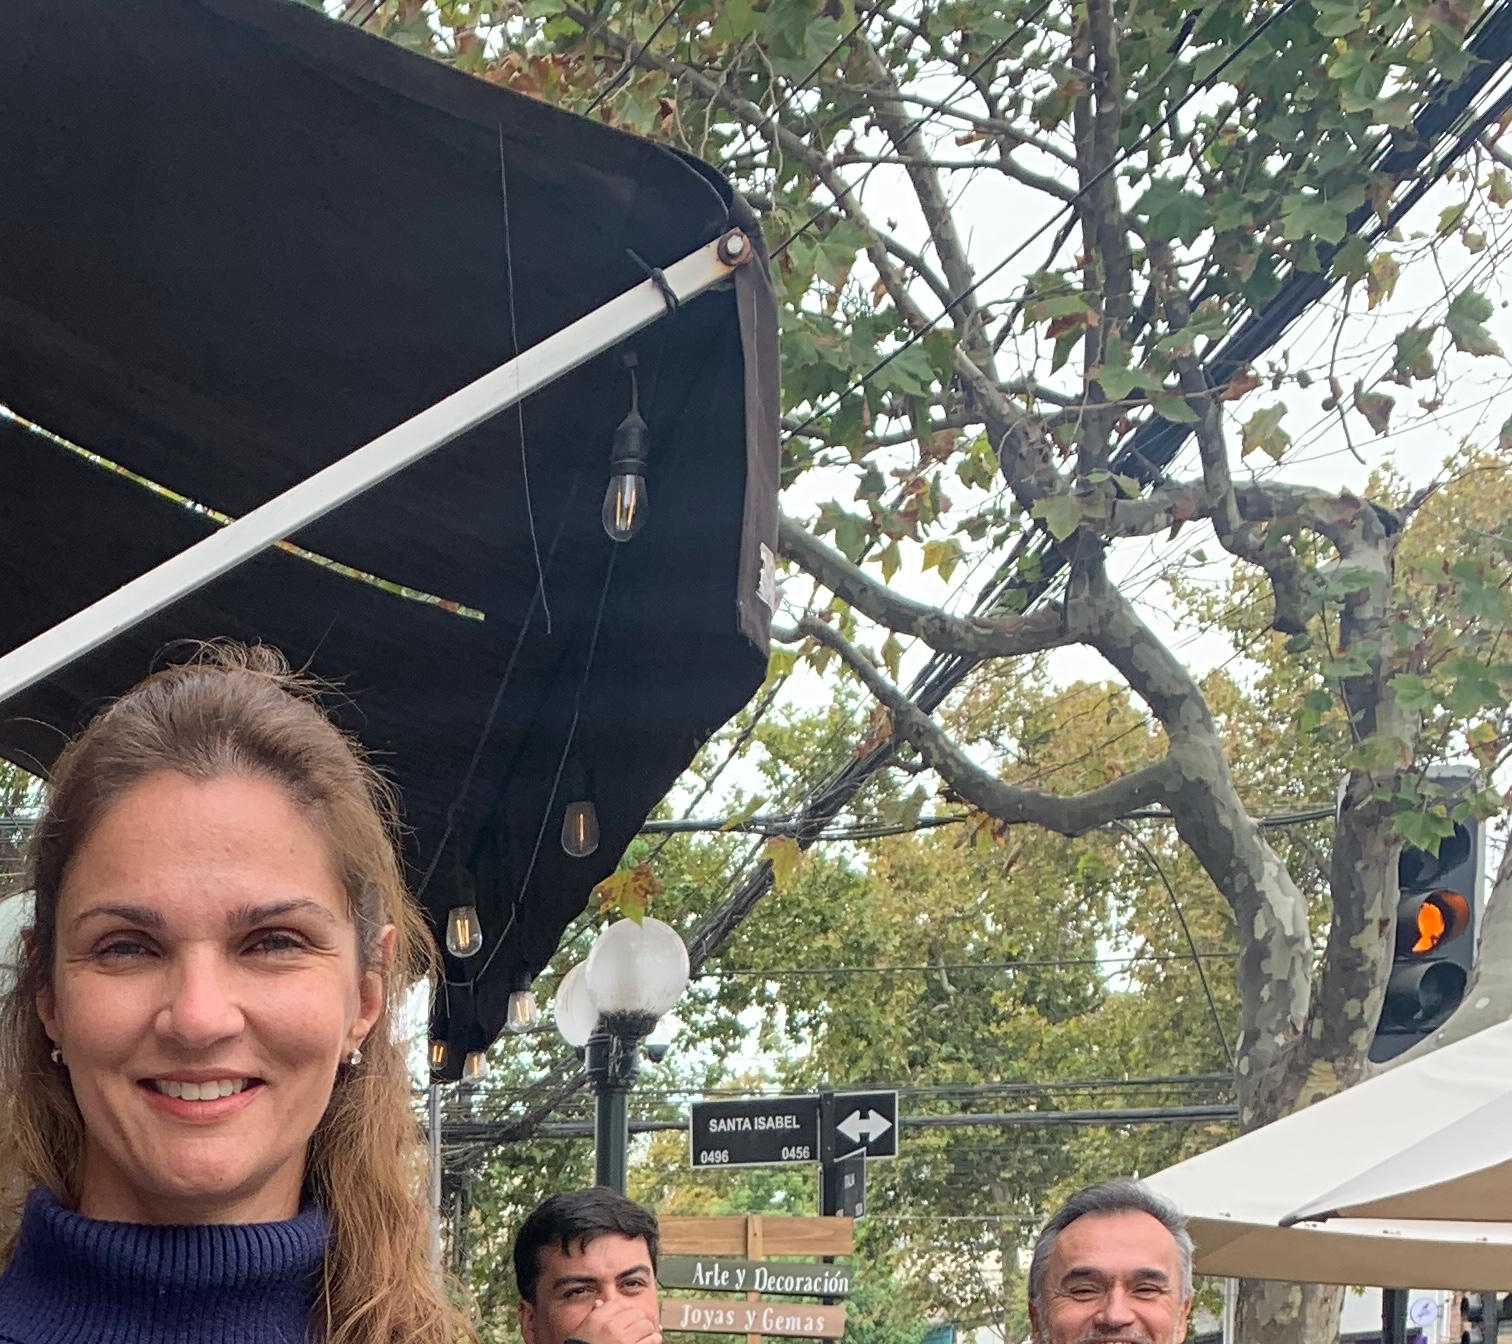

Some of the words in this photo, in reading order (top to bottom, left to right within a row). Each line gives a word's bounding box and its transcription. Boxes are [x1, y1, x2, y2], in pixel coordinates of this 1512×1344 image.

[709, 1117, 752, 1133] SANTA
[754, 1115, 800, 1130] ISABEL
[701, 1150, 729, 1164] 0496
[782, 1146, 810, 1160] 0456
[692, 1262, 730, 1286] Arte
[736, 1268, 746, 1290] y
[754, 1266, 849, 1293] Decoración
[680, 1304, 734, 1330] Joyas
[745, 1308, 757, 1330] y
[762, 1308, 825, 1332] Gemas
